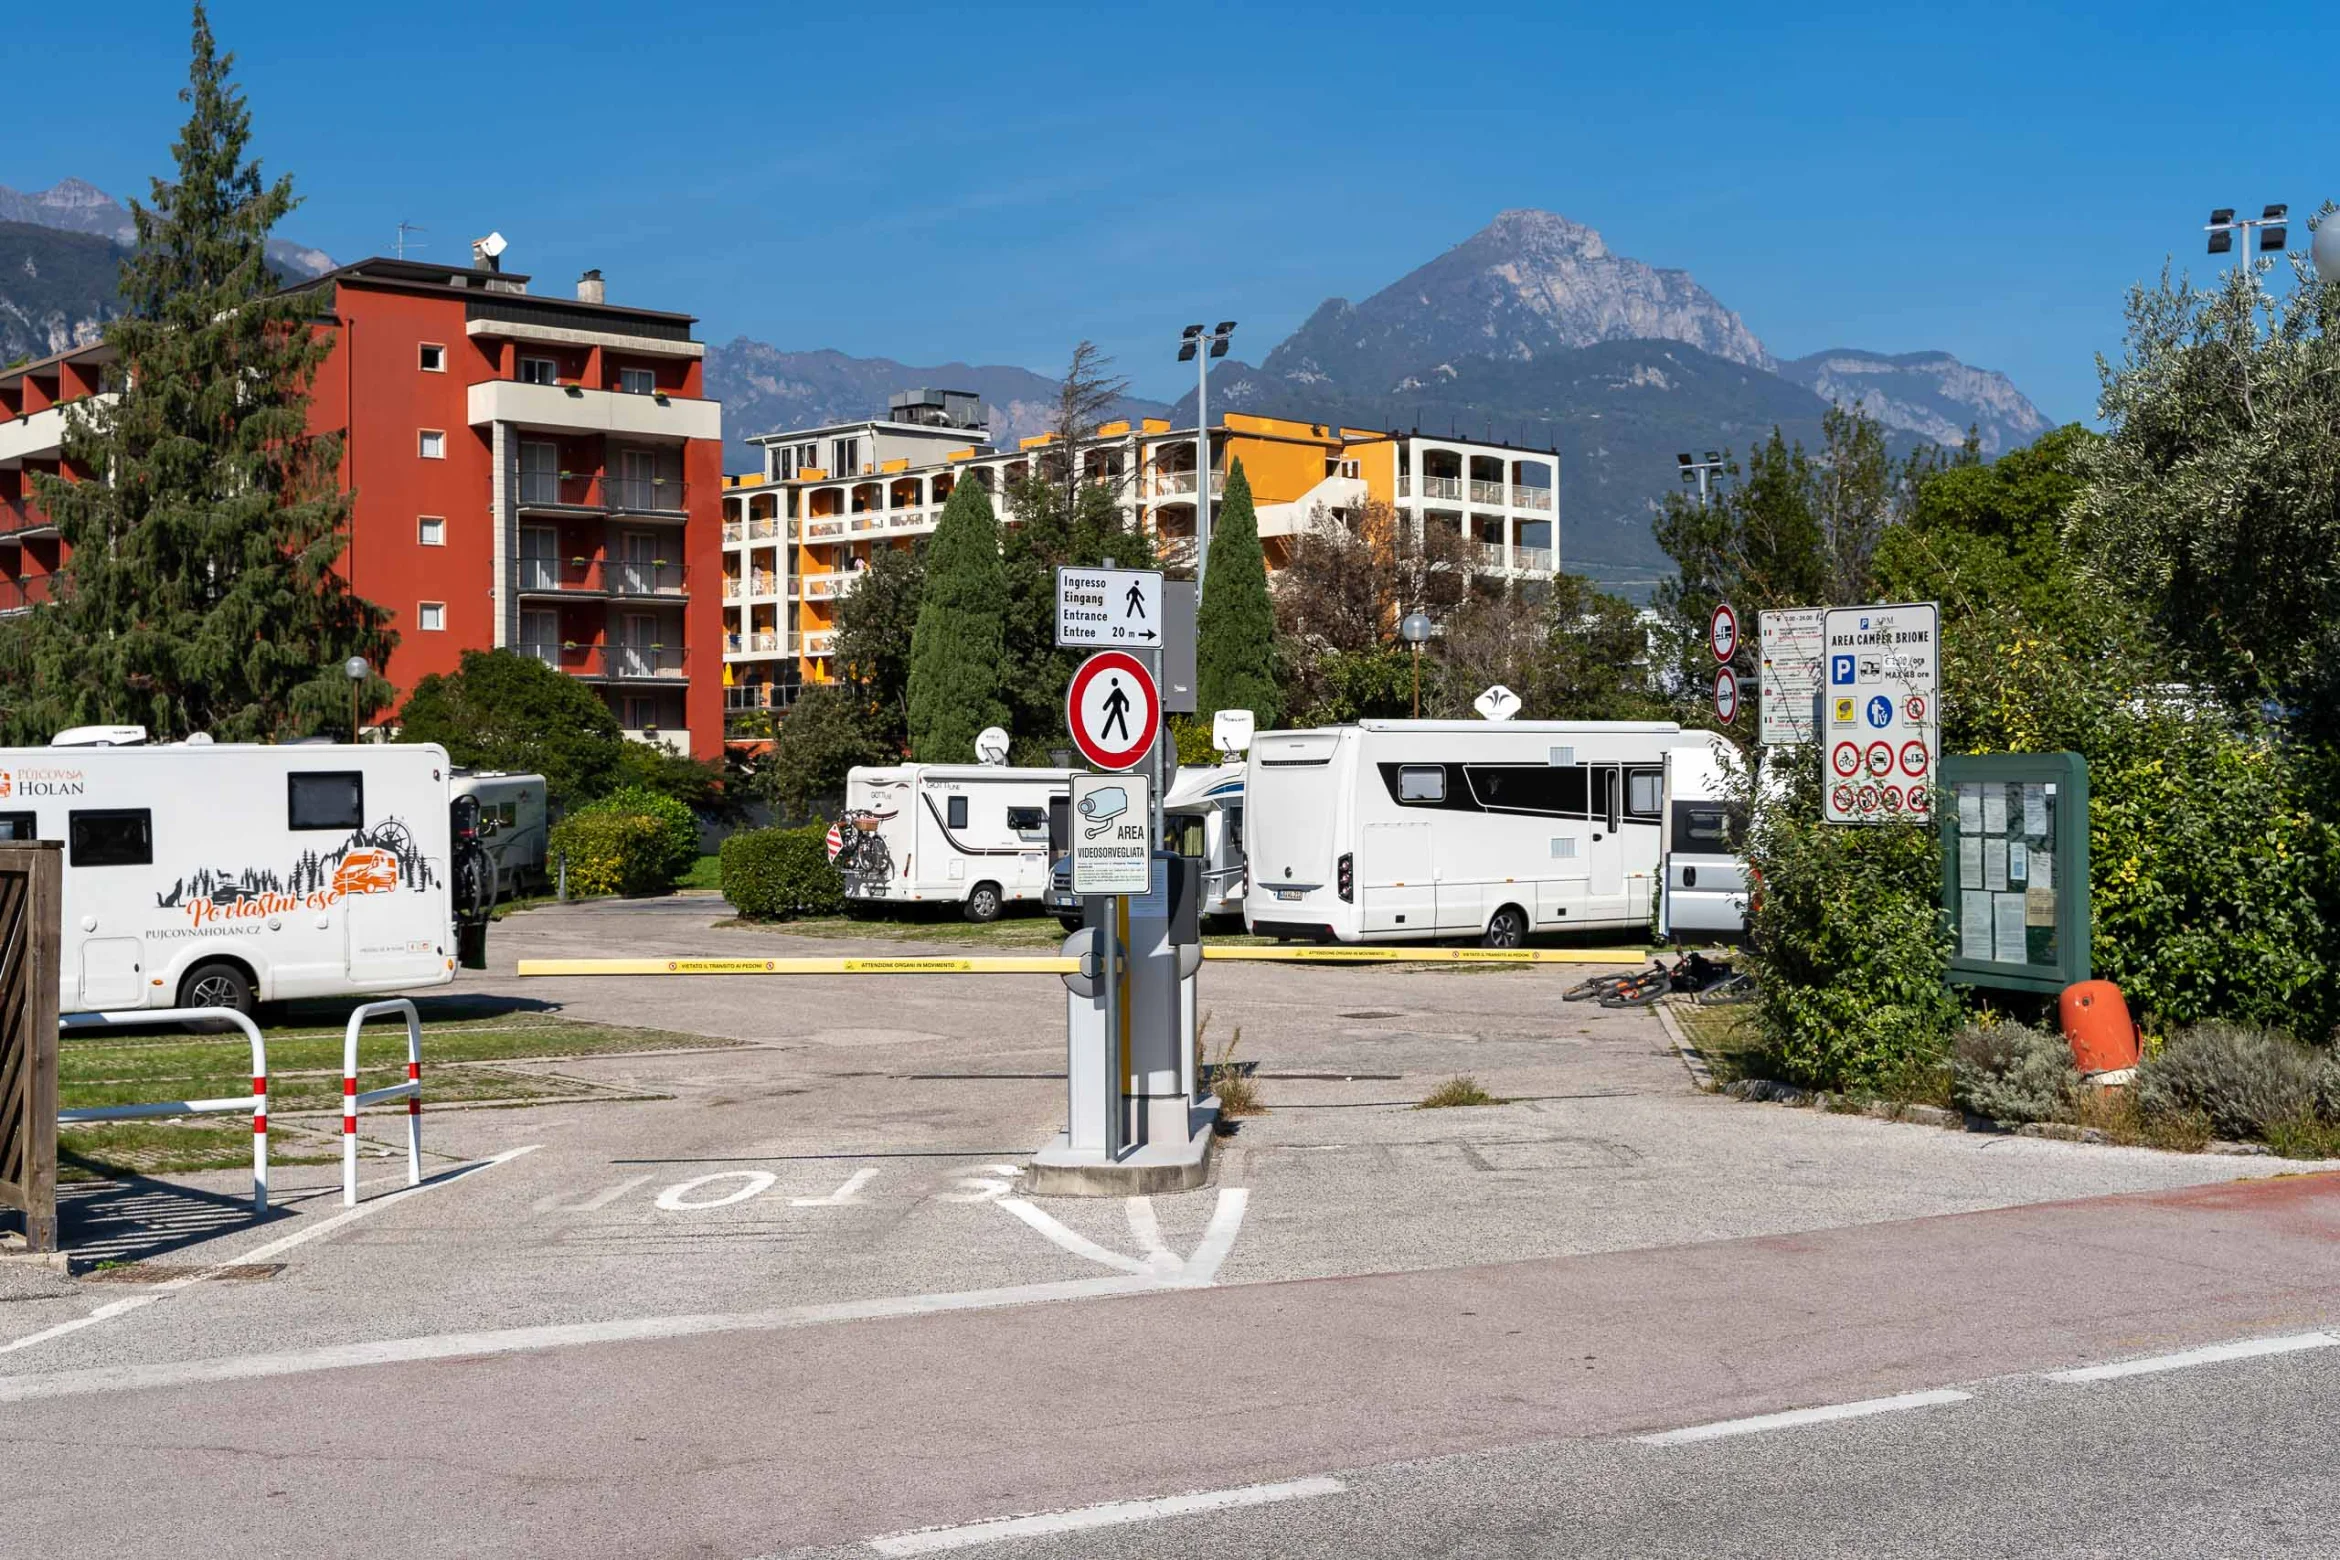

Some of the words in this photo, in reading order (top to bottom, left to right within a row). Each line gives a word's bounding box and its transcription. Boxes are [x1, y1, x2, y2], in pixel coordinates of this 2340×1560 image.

[1064, 575, 1106, 589] Ingresso
[1064, 591, 1103, 606] Eingang
[1063, 609, 1107, 621] Entrance
[1063, 626, 1096, 637] Entree
[1112, 626, 1124, 637] 20
[1832, 634, 1854, 646] AREA
[1857, 632, 1893, 645] CAMPER
[1896, 631, 1929, 643] BRIONE
[1885, 671, 1901, 679] MAX
[19, 781, 83, 796] HOLAN
[1117, 825, 1144, 840] AREA
[1077, 847, 1144, 858] VIDEOSORVEGLIATA
[186, 897, 220, 928] Po
[306, 891, 339, 911] ose
[145, 925, 261, 940] PUJCOVNAHOLAN.CZ
